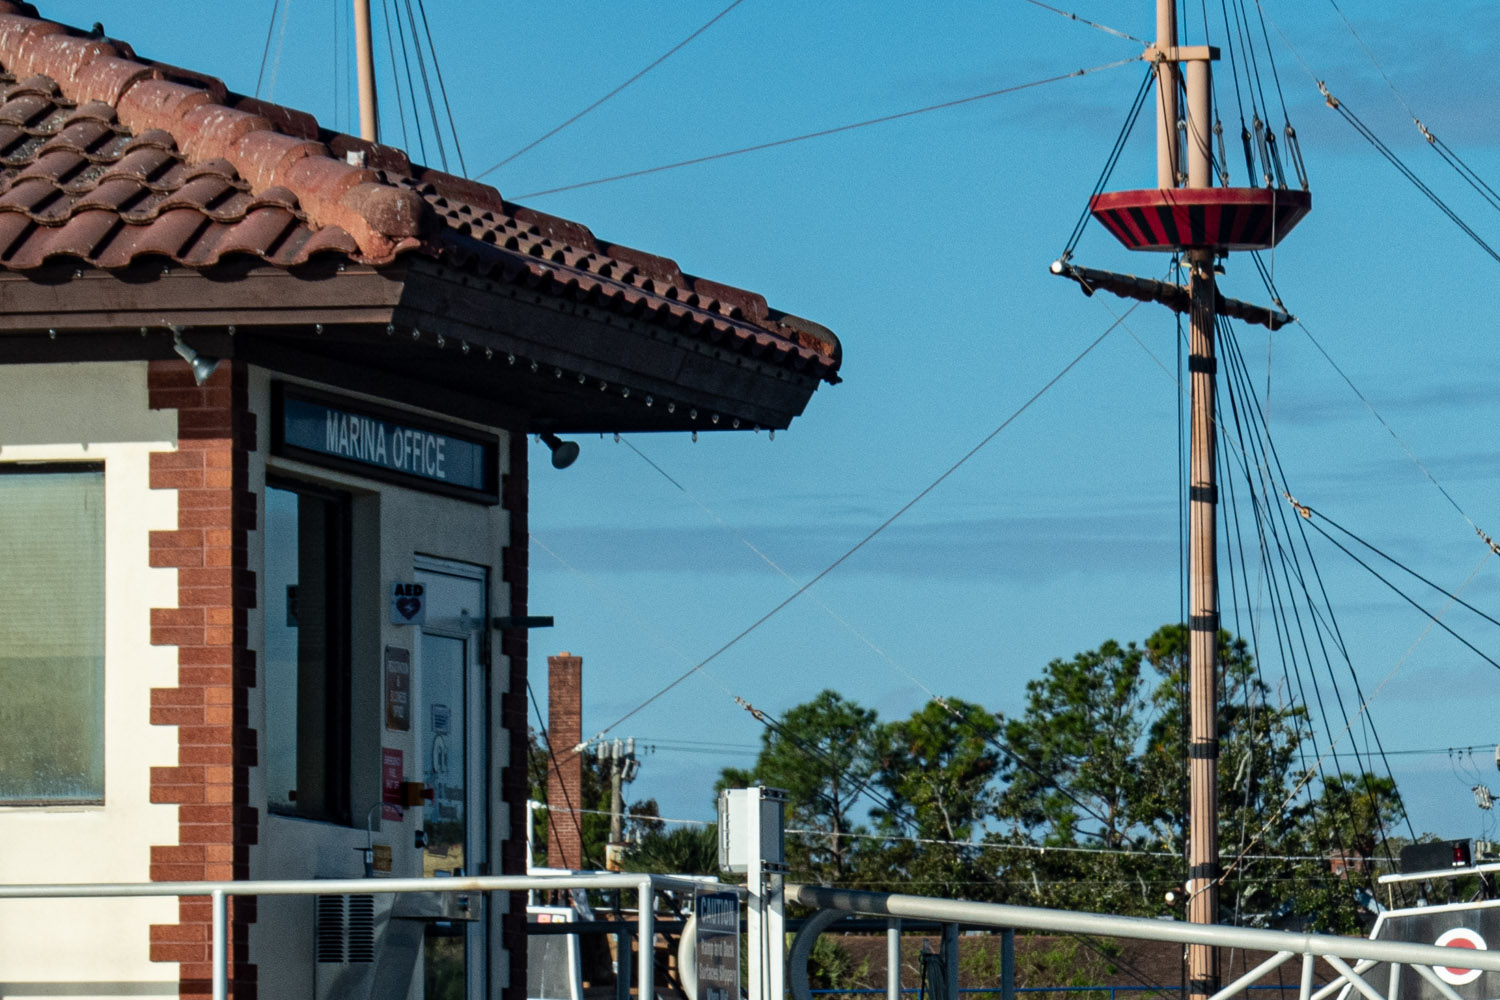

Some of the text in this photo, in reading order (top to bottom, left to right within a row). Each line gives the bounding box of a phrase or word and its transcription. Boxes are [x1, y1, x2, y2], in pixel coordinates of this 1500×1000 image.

[326, 410, 446, 479] MARINA OFFICE
[395, 583, 424, 596] AED
[701, 896, 735, 926] CAUTION
